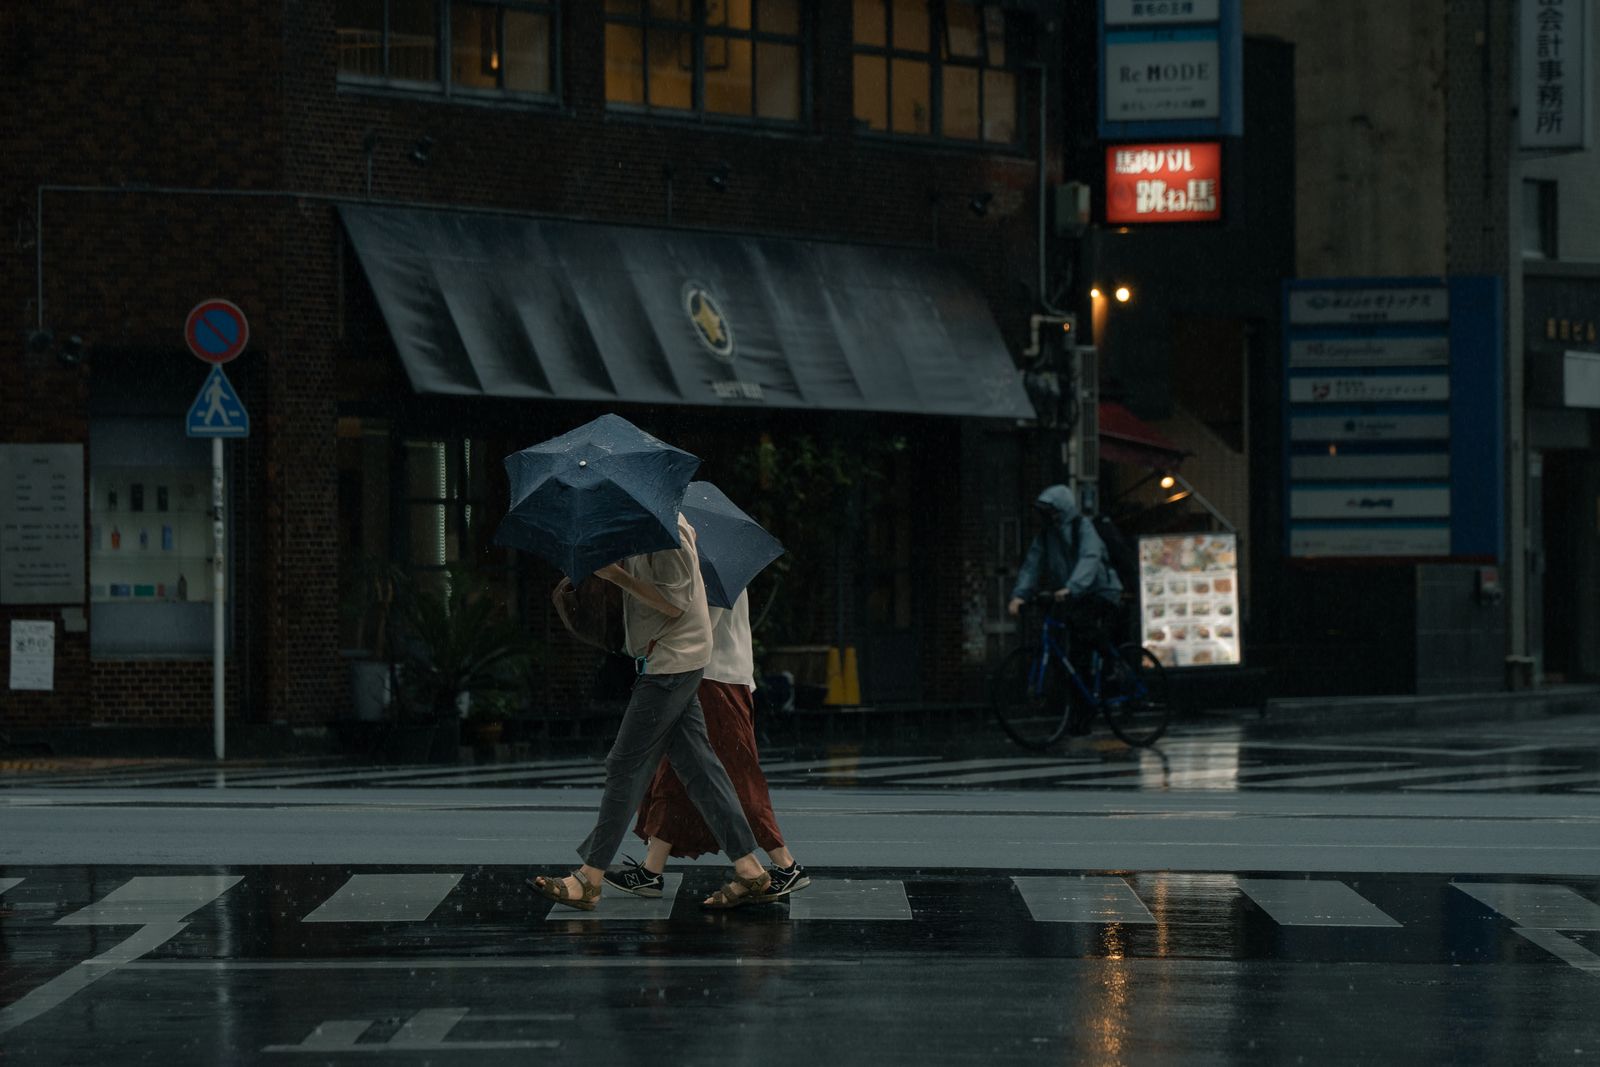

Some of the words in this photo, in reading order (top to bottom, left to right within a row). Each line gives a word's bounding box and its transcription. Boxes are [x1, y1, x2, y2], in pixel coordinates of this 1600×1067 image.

[1147, 62, 1210, 81] MODE
[1536, 0, 1564, 135] 会計事務所
